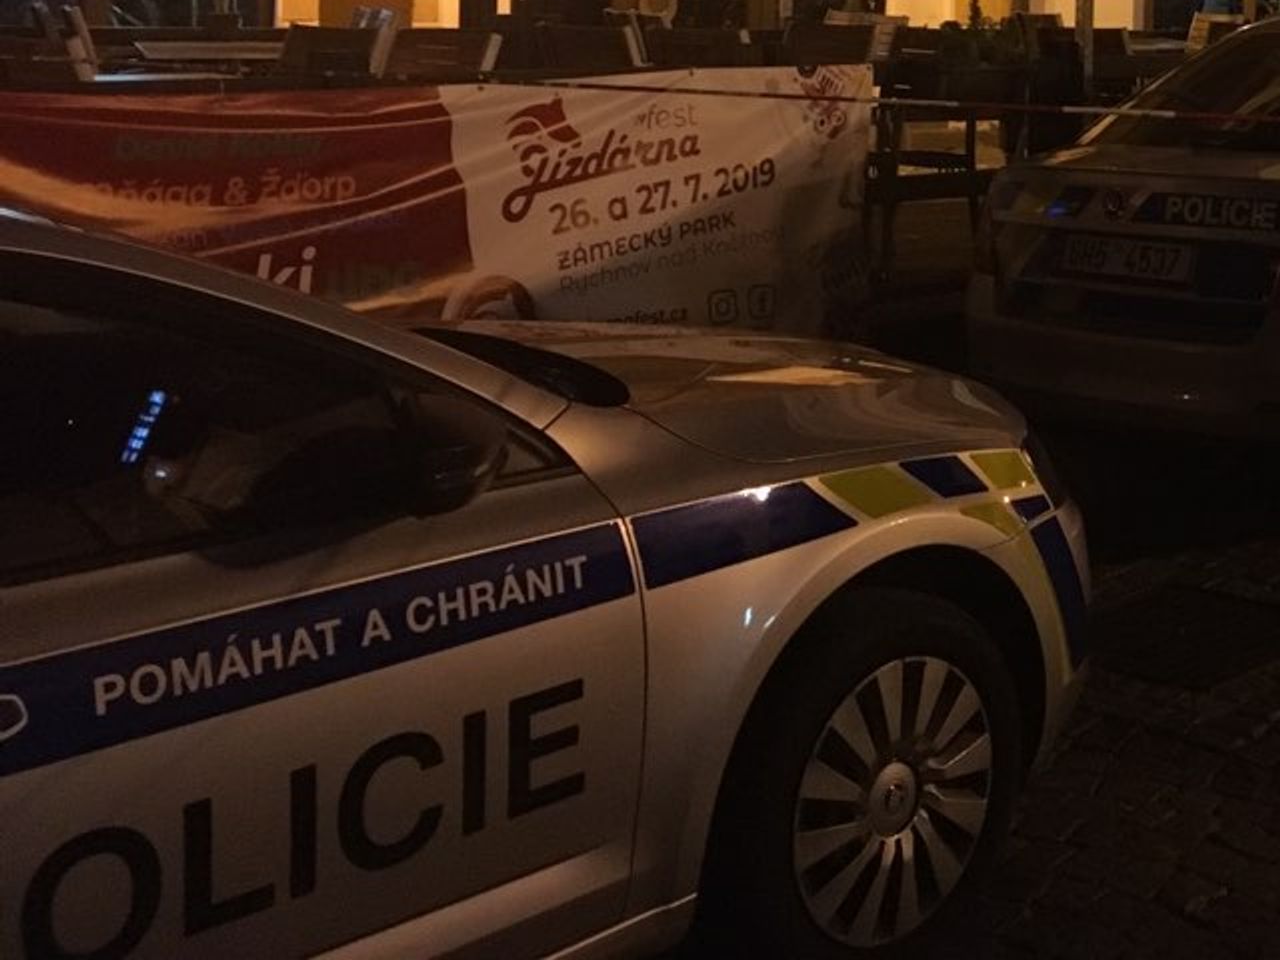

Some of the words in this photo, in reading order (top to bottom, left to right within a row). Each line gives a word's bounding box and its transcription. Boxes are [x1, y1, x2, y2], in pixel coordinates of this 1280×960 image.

[647, 103, 698, 130] fest
[223, 177, 248, 205] &
[502, 129, 701, 223] Jízdárna
[549, 197, 599, 235] 26.
[608, 195, 628, 221] a
[635, 180, 677, 215] 27.
[684, 173, 709, 204] 7.
[714, 157, 776, 198] 2019
[557, 223, 672, 271] ZÁMECKÝ
[679, 211, 736, 240] PARK
[1163, 195, 1279, 231] POLICIE
[92, 617, 343, 717] POMÁHAT
[360, 608, 392, 647] A
[405, 554, 588, 634] CHRÁNIT
[20, 678, 586, 960] OLICIE
